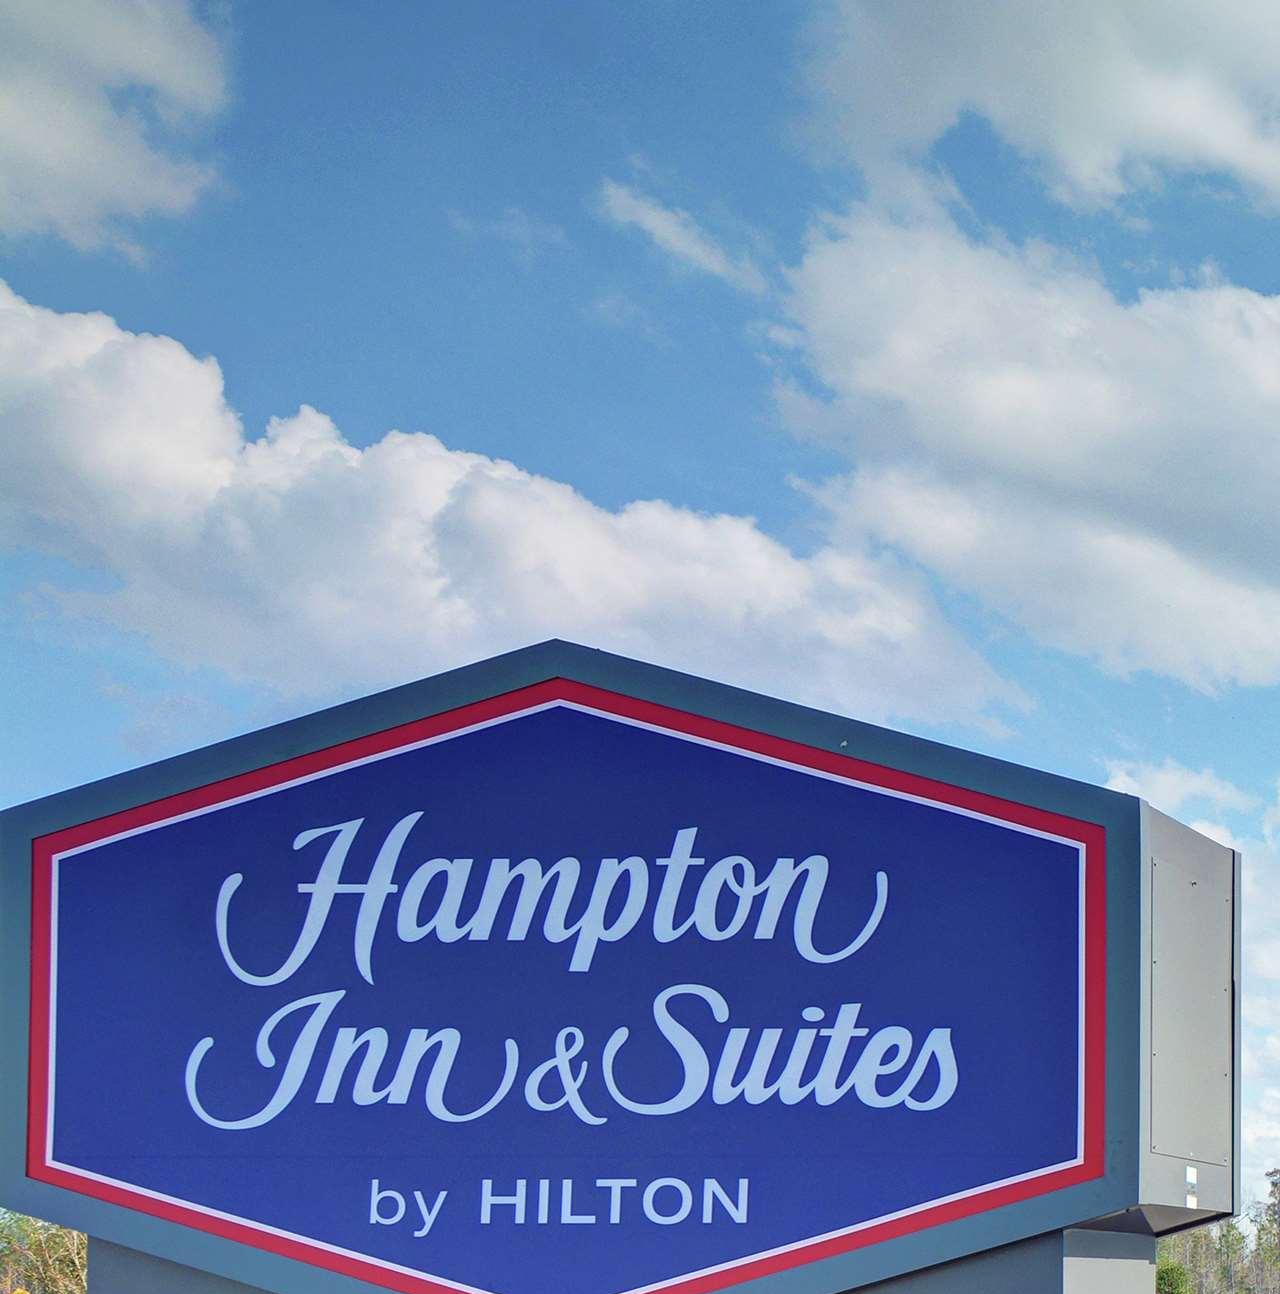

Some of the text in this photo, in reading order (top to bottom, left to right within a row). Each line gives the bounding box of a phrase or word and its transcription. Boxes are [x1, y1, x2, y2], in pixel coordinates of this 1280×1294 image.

[216, 811, 888, 987] Hampton
[185, 983, 959, 1130] Inn & Suites
[369, 1177, 750, 1238] by HILTON
